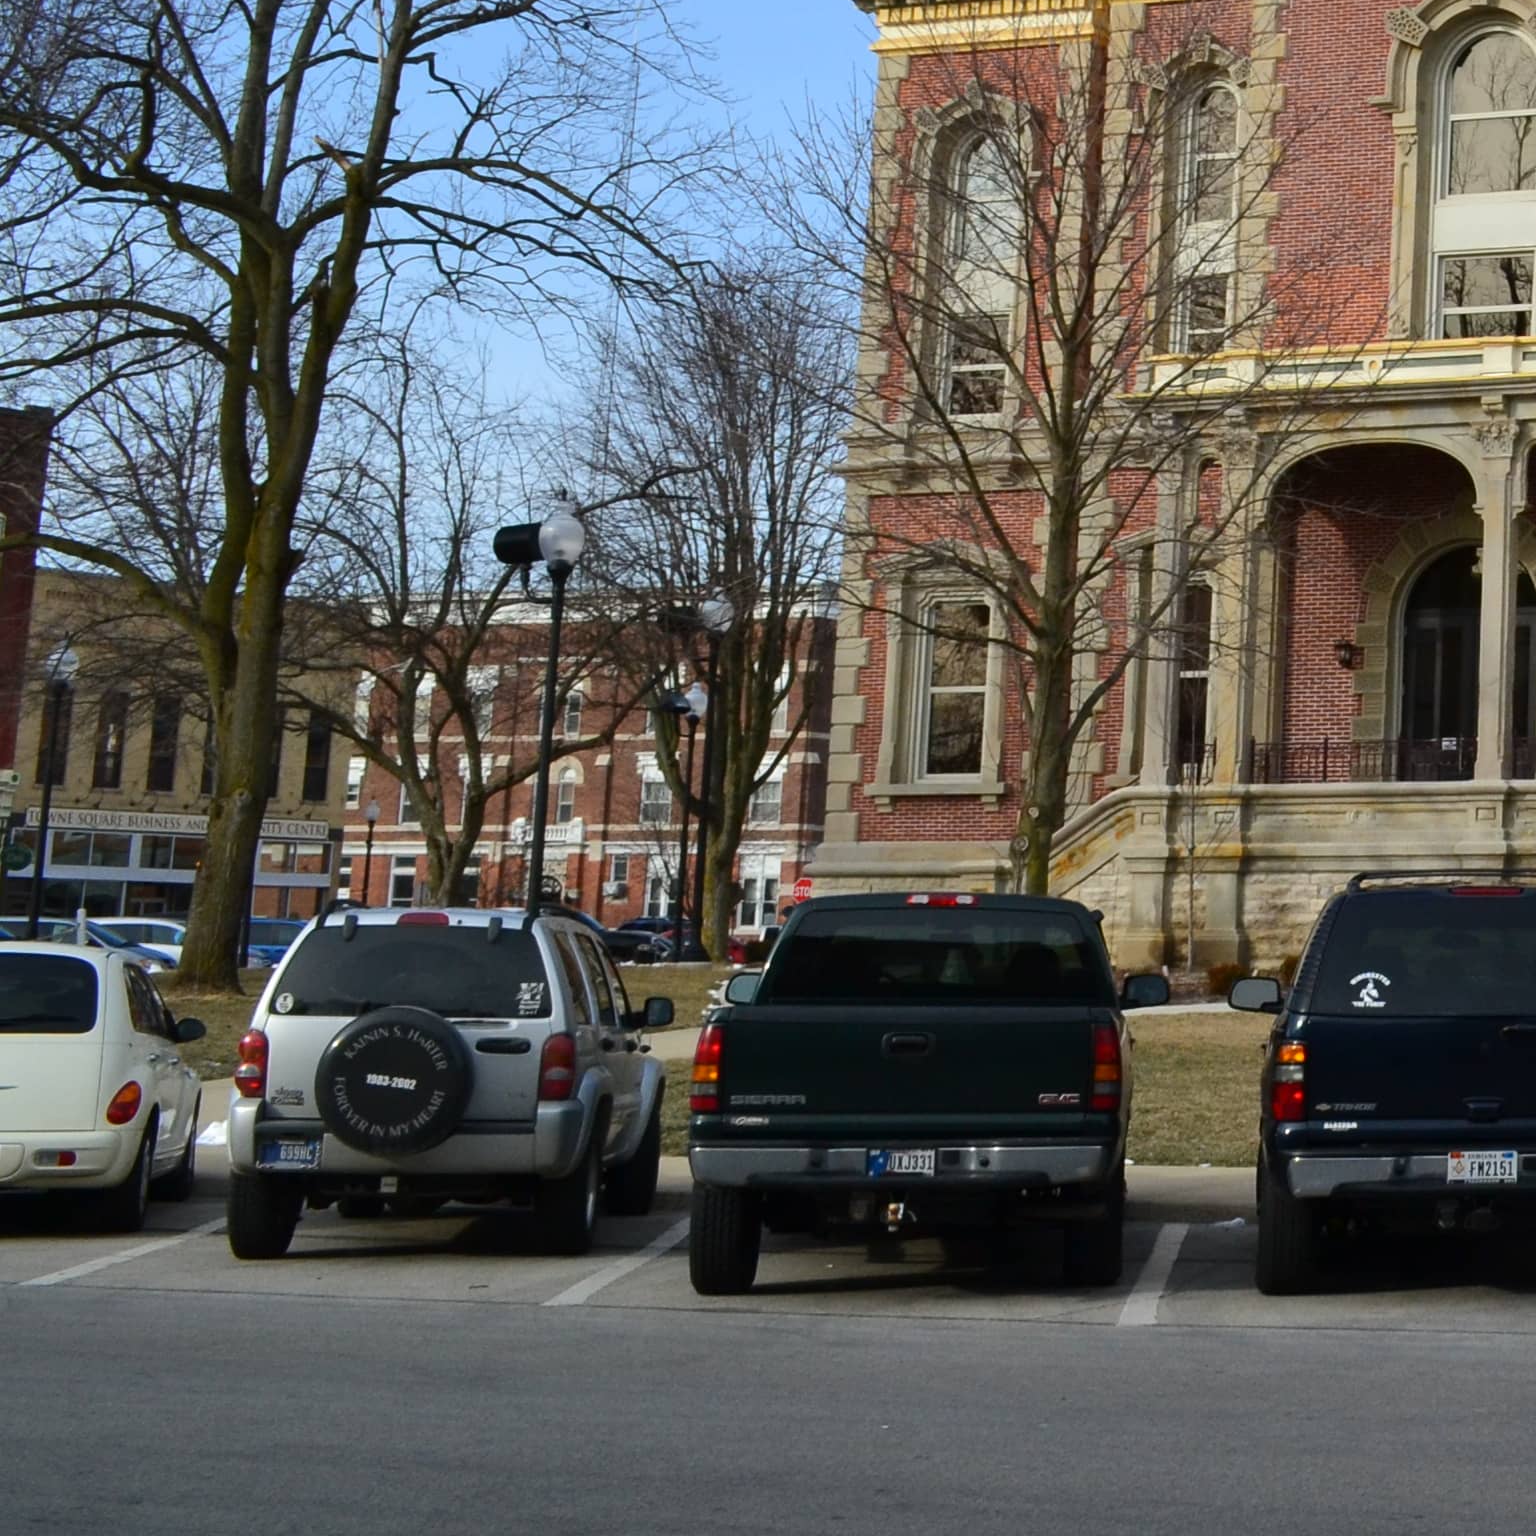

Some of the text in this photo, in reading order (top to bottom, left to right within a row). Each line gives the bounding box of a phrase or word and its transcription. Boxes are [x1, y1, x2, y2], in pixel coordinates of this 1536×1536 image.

[78, 811, 123, 828] SQUARE
[128, 813, 181, 830] BUSINESS
[793, 886, 810, 897] STO
[366, 1073, 417, 1090] 1983-2002
[334, 1077, 369, 1135] FOREVER
[369, 1125, 385, 1137] IN
[388, 1122, 410, 1137] MY
[413, 1089, 445, 1128] HEART
[730, 1094, 806, 1105] SIERRA
[1470, 1161, 1514, 1177] FM2151
